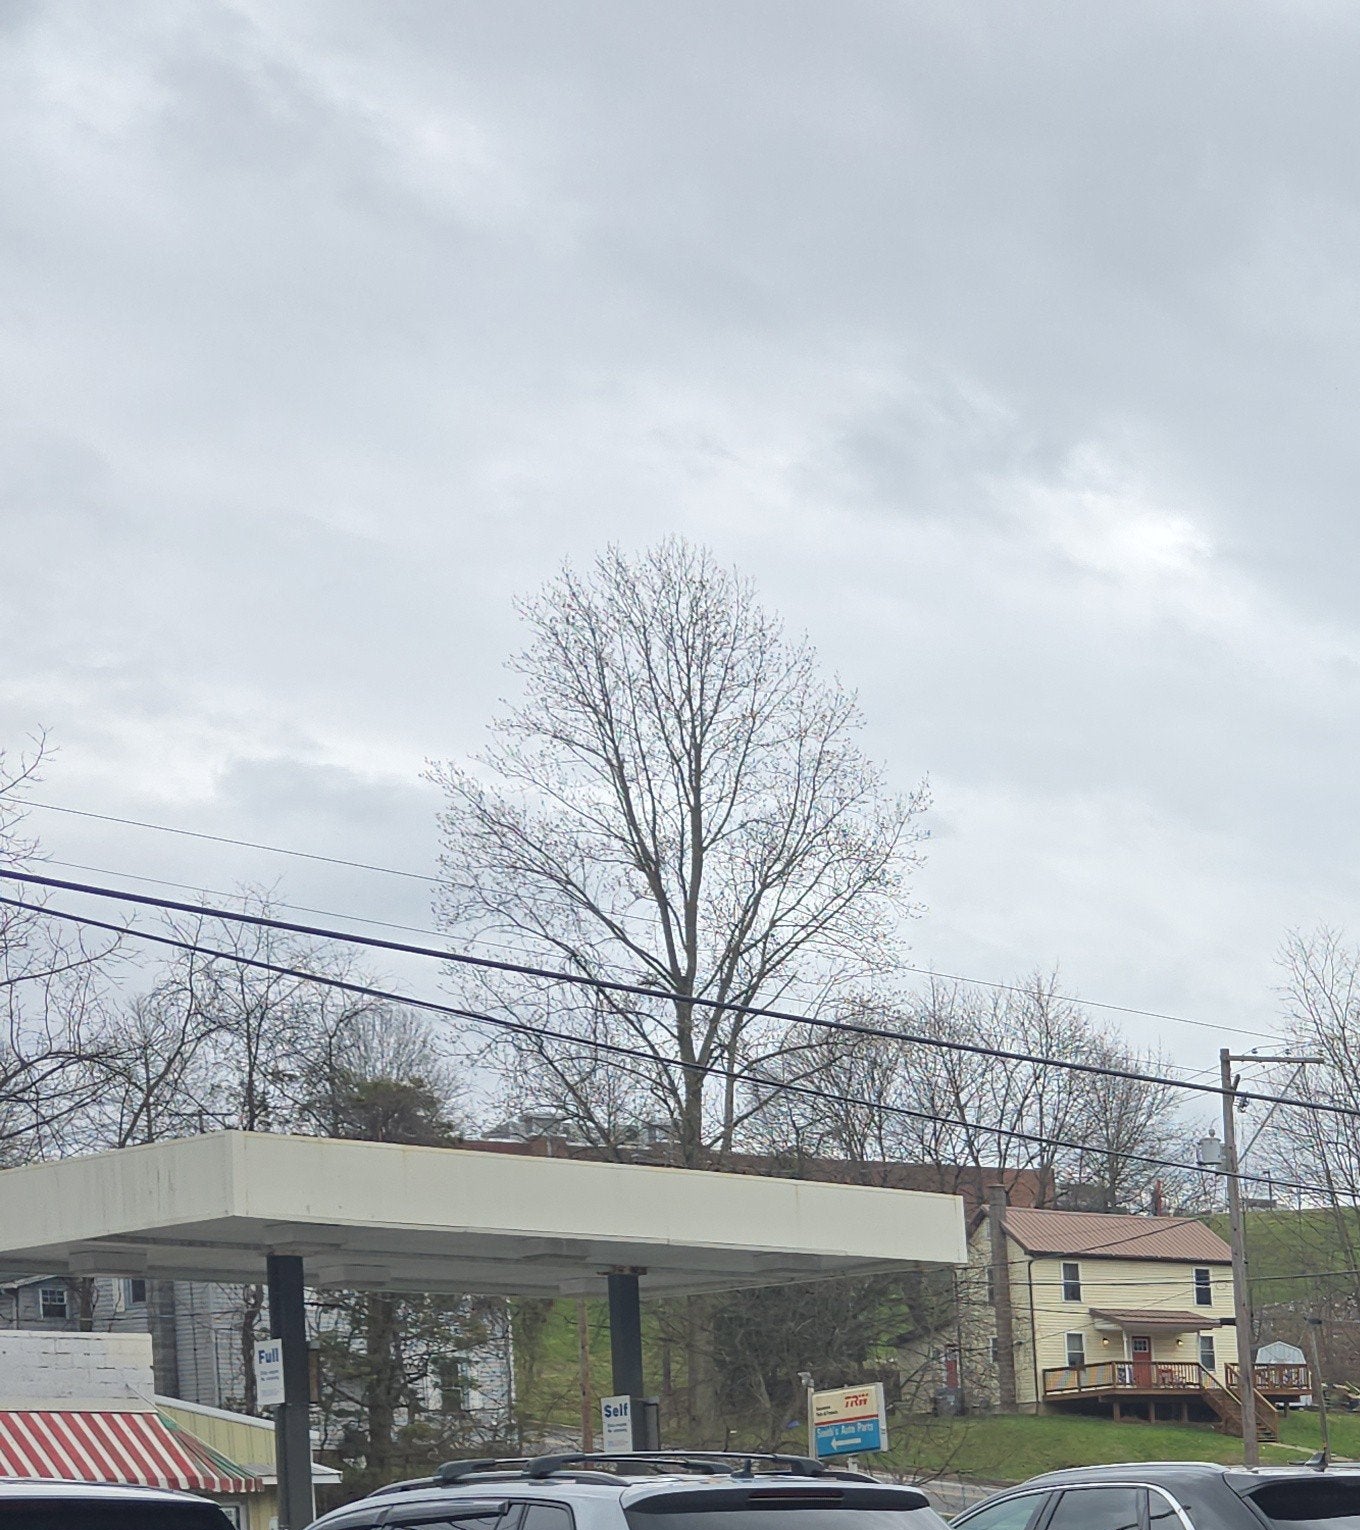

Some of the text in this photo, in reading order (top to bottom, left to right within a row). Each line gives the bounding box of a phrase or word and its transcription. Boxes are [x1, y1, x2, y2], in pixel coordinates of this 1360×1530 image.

[258, 1348, 279, 1364] Full
[844, 1392, 869, 1408] TRW
[604, 1403, 628, 1418] Self
